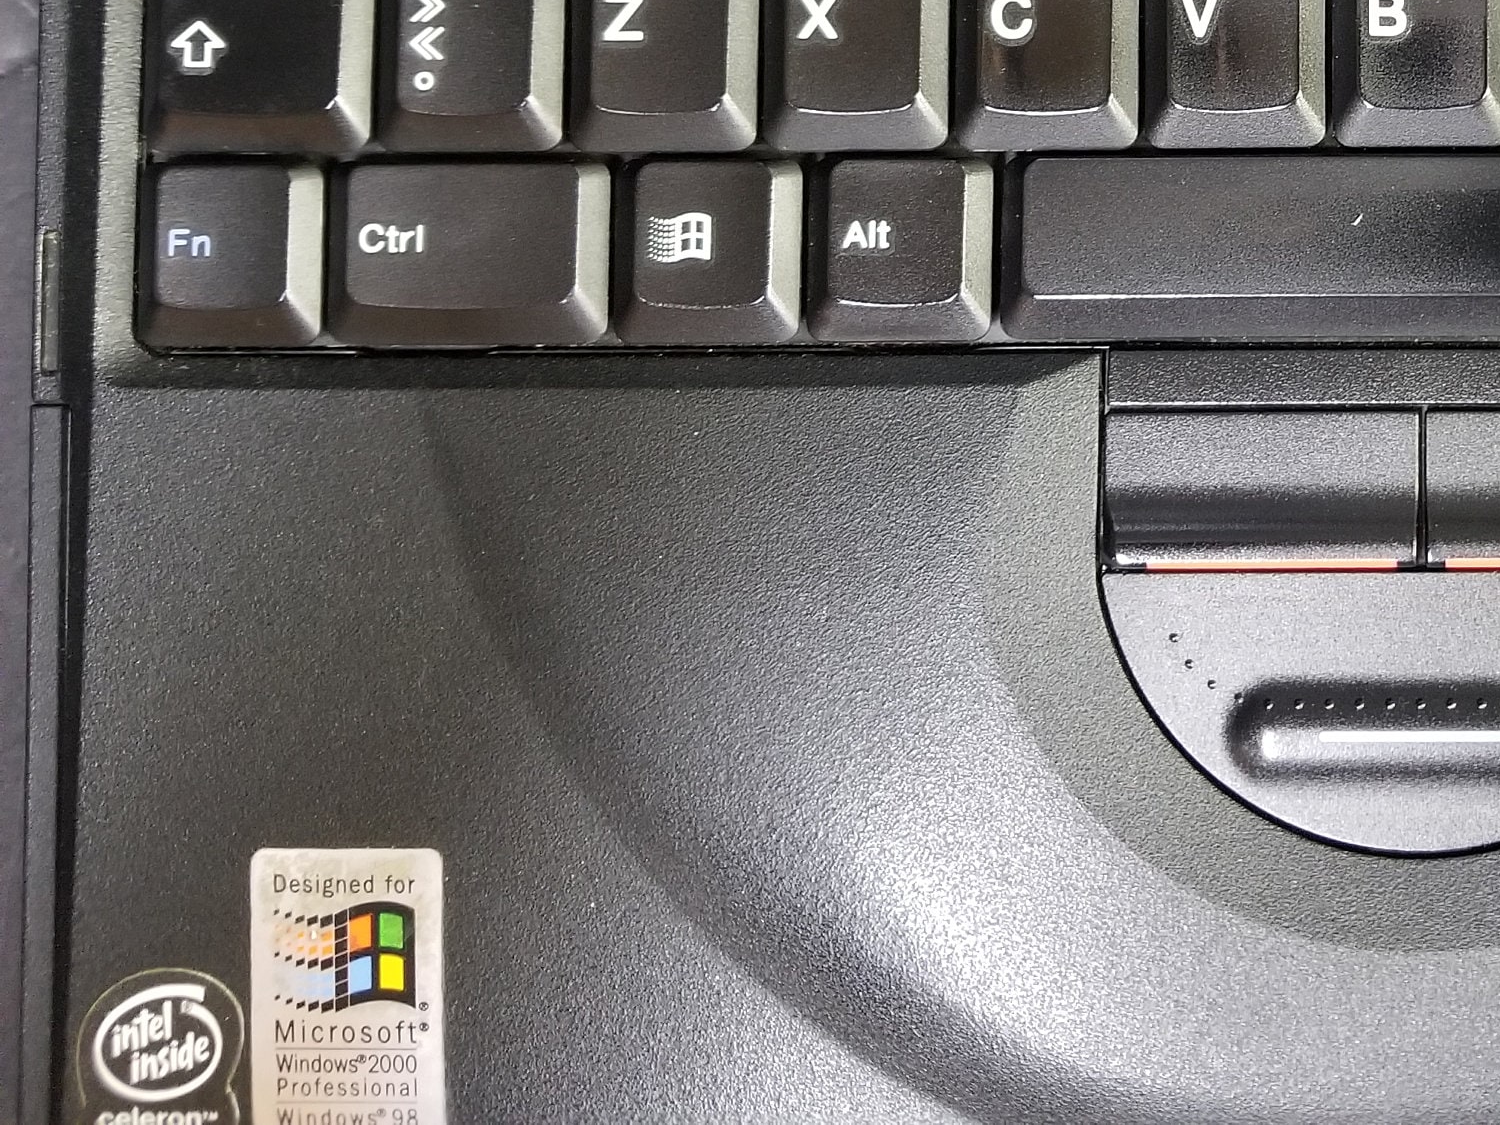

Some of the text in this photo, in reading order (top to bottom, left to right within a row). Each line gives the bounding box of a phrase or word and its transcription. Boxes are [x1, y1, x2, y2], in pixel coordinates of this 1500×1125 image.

[167, 228, 211, 257] Fn
[358, 223, 425, 254] Ctrl
[841, 220, 892, 249] Alt
[273, 873, 416, 897] Designed for
[111, 1000, 173, 1058] intel
[129, 1031, 210, 1085] inside
[276, 1077, 418, 1097] Professional
[391, 1107, 418, 1125] 98
